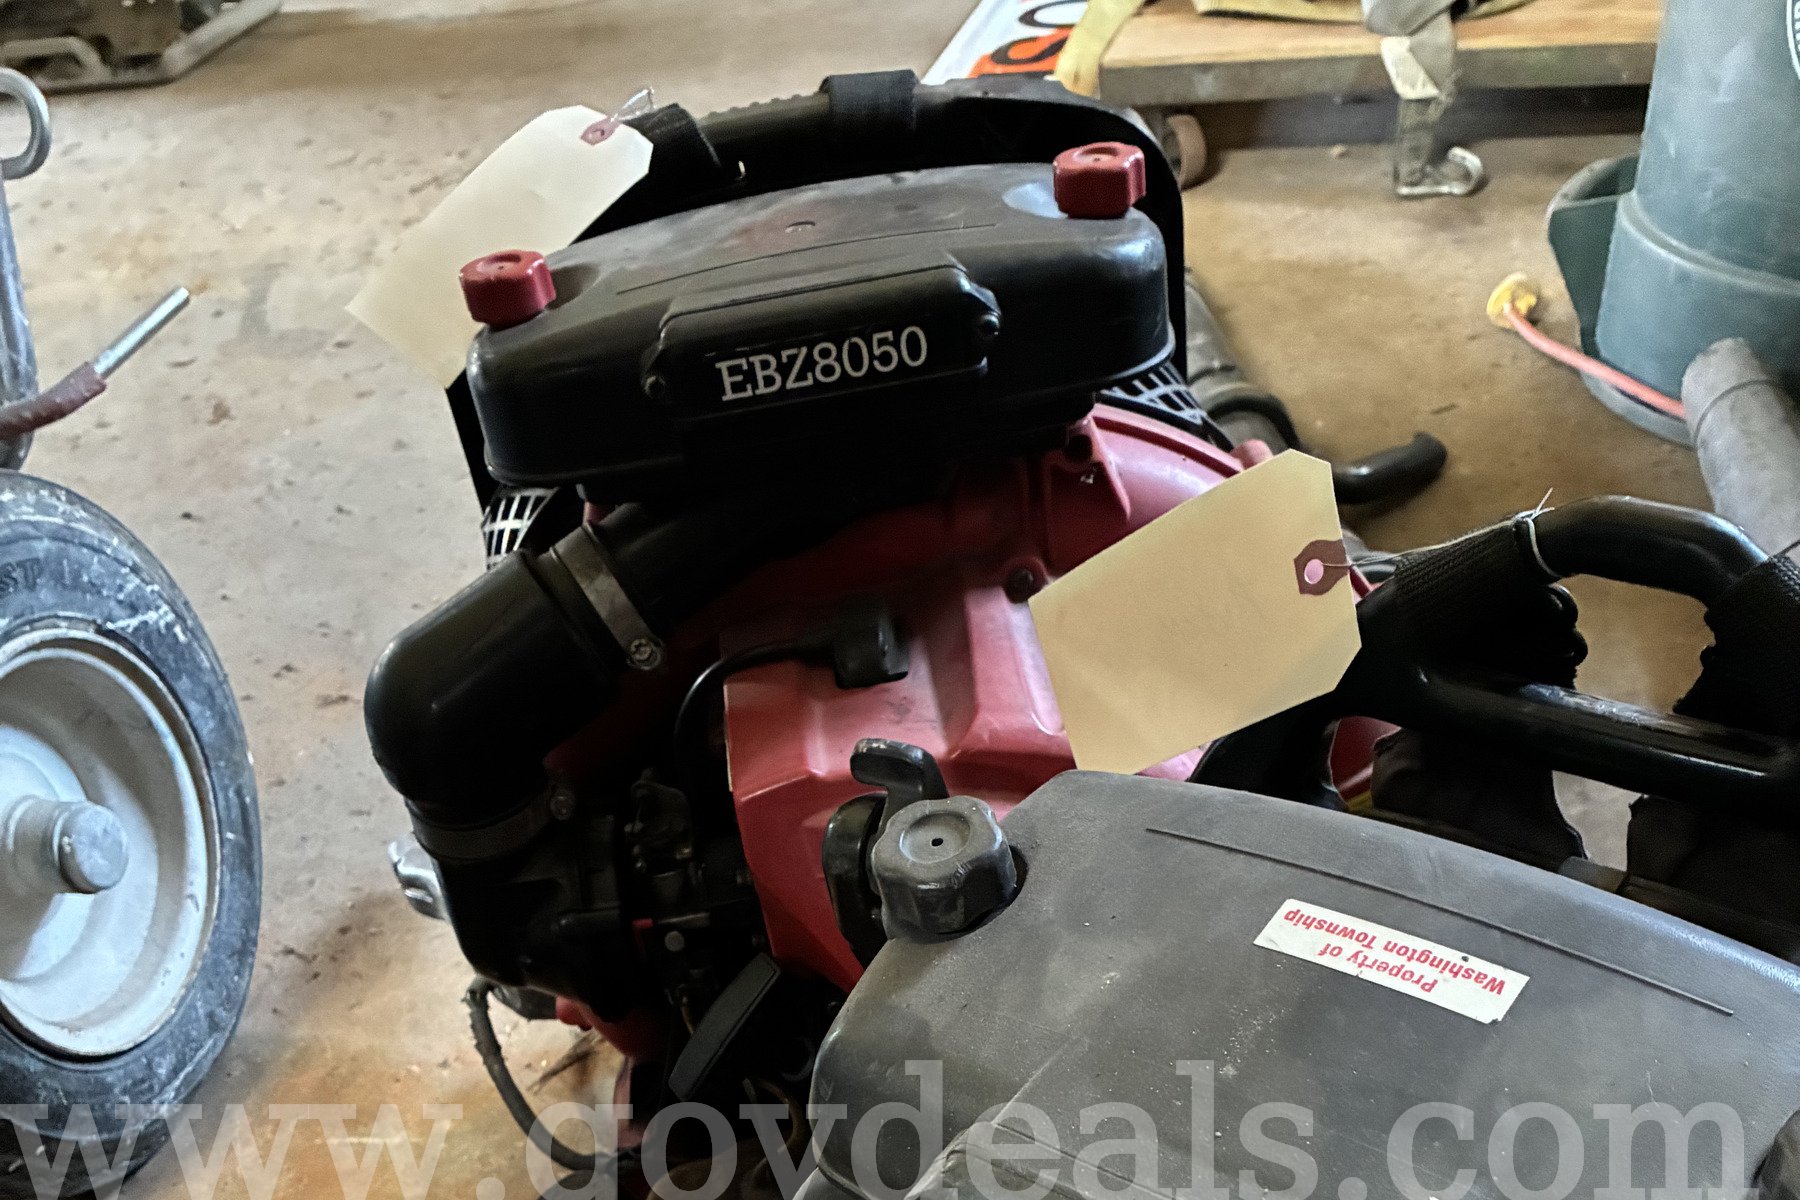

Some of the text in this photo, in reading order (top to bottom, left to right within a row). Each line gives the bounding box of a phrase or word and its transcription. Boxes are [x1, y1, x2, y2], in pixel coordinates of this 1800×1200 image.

[714, 325, 928, 401] EBZ8050
[1284, 909, 1505, 995] Washington Township
[1317, 942, 1439, 993] Property of
